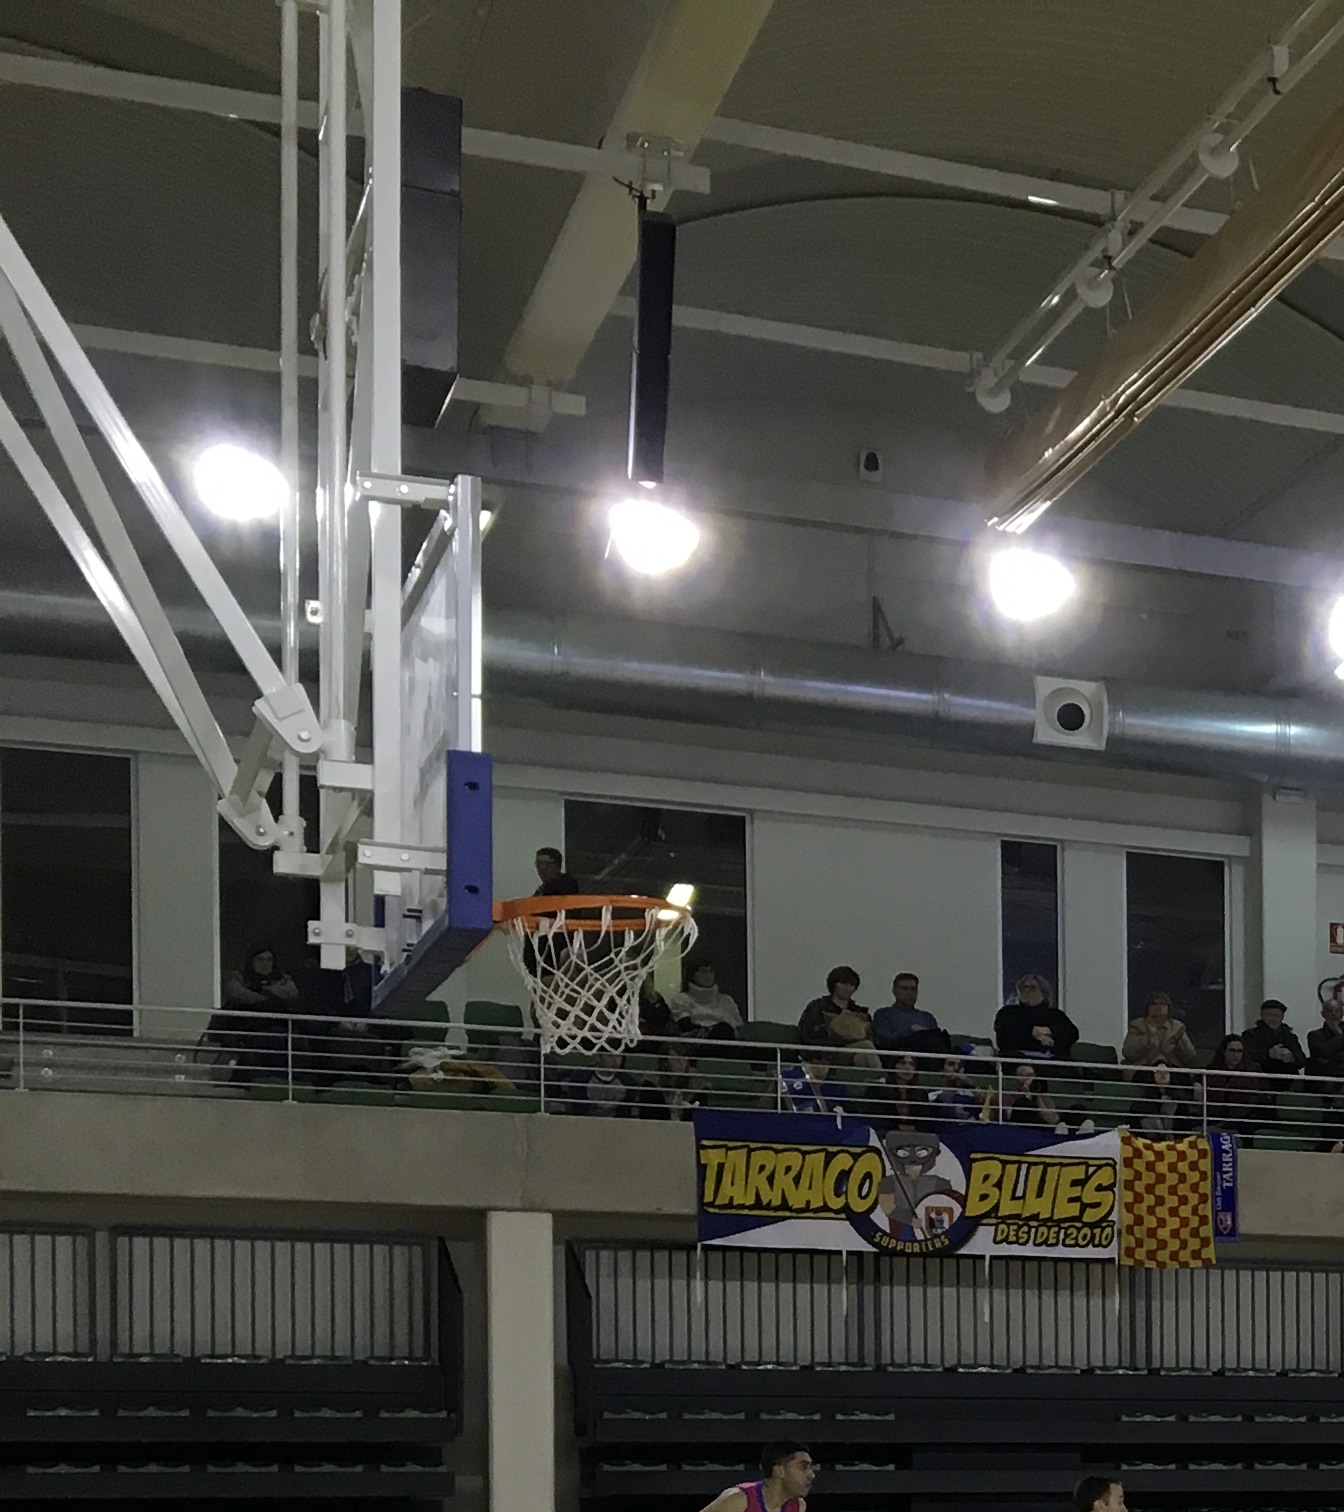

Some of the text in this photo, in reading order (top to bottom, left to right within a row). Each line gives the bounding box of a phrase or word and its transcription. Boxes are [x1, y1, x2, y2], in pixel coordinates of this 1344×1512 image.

[700, 1147, 1116, 1223] TARRACO BLUES
[873, 1231, 950, 1253] SUPPORTERS
[1063, 1226, 1113, 1247] 2010
